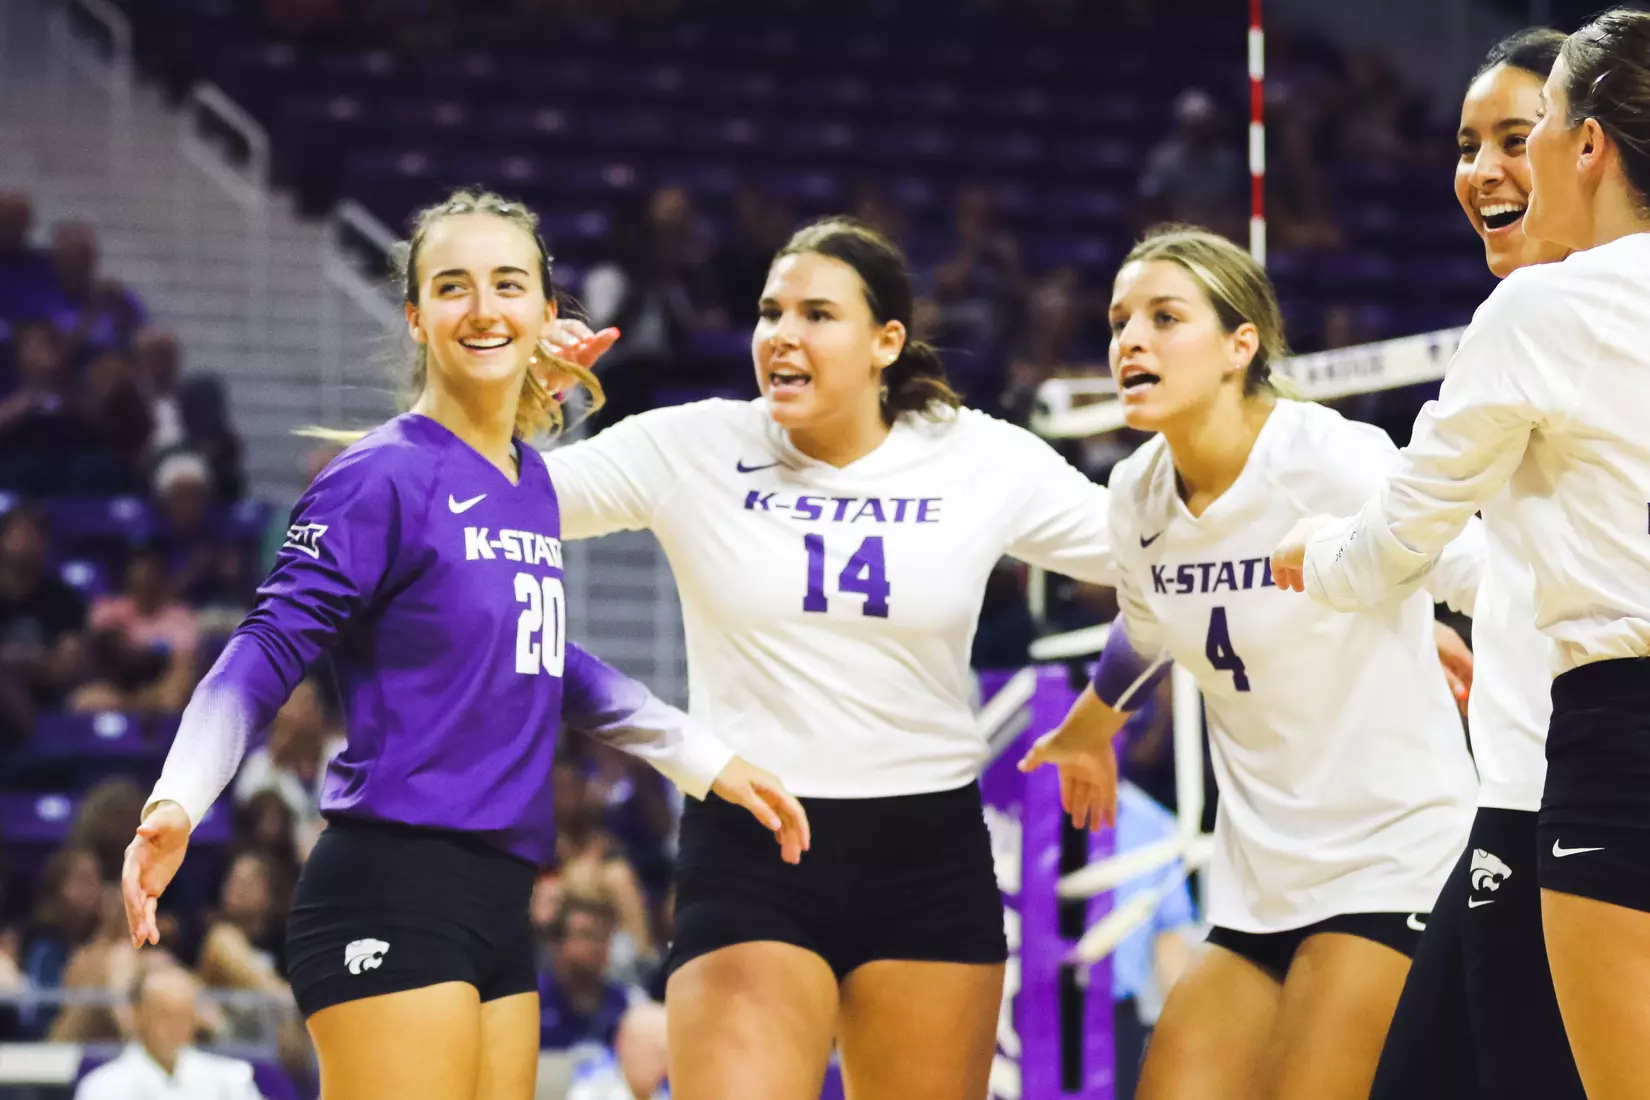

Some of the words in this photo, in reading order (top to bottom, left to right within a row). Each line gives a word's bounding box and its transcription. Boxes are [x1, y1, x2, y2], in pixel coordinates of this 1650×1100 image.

[464, 527, 564, 570] K-STAT
[744, 490, 943, 523] K-STATE
[803, 533, 891, 618] 14
[513, 572, 566, 678] 20
[1205, 606, 1251, 692] 4
